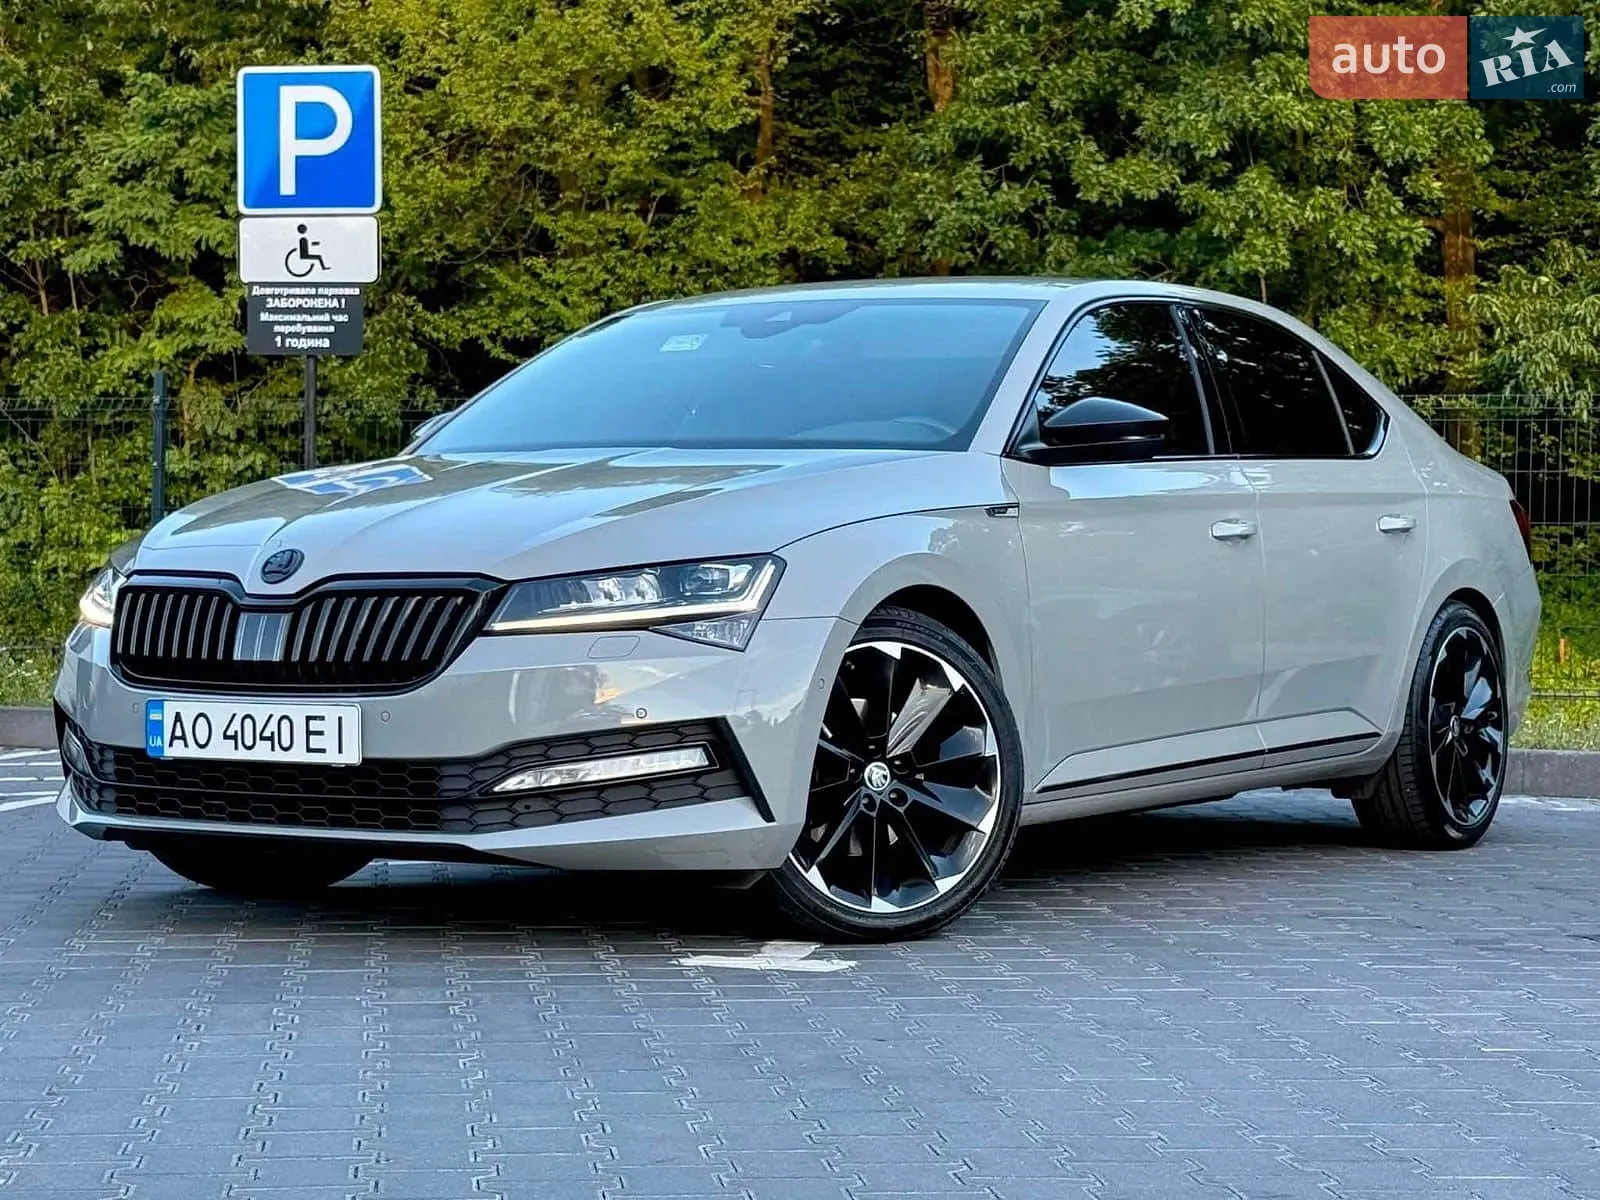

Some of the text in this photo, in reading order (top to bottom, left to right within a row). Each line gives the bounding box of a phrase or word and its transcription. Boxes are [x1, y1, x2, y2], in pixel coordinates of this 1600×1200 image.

[279, 85, 353, 196] P
[265, 297, 339, 308] ЗАБОРОНЕНА
[260, 312, 349, 322] Максимальний час
[273, 323, 335, 334] перебування
[274, 335, 330, 349] 1 година
[168, 711, 344, 754] AO 4040 EI
[149, 736, 163, 746] UA
